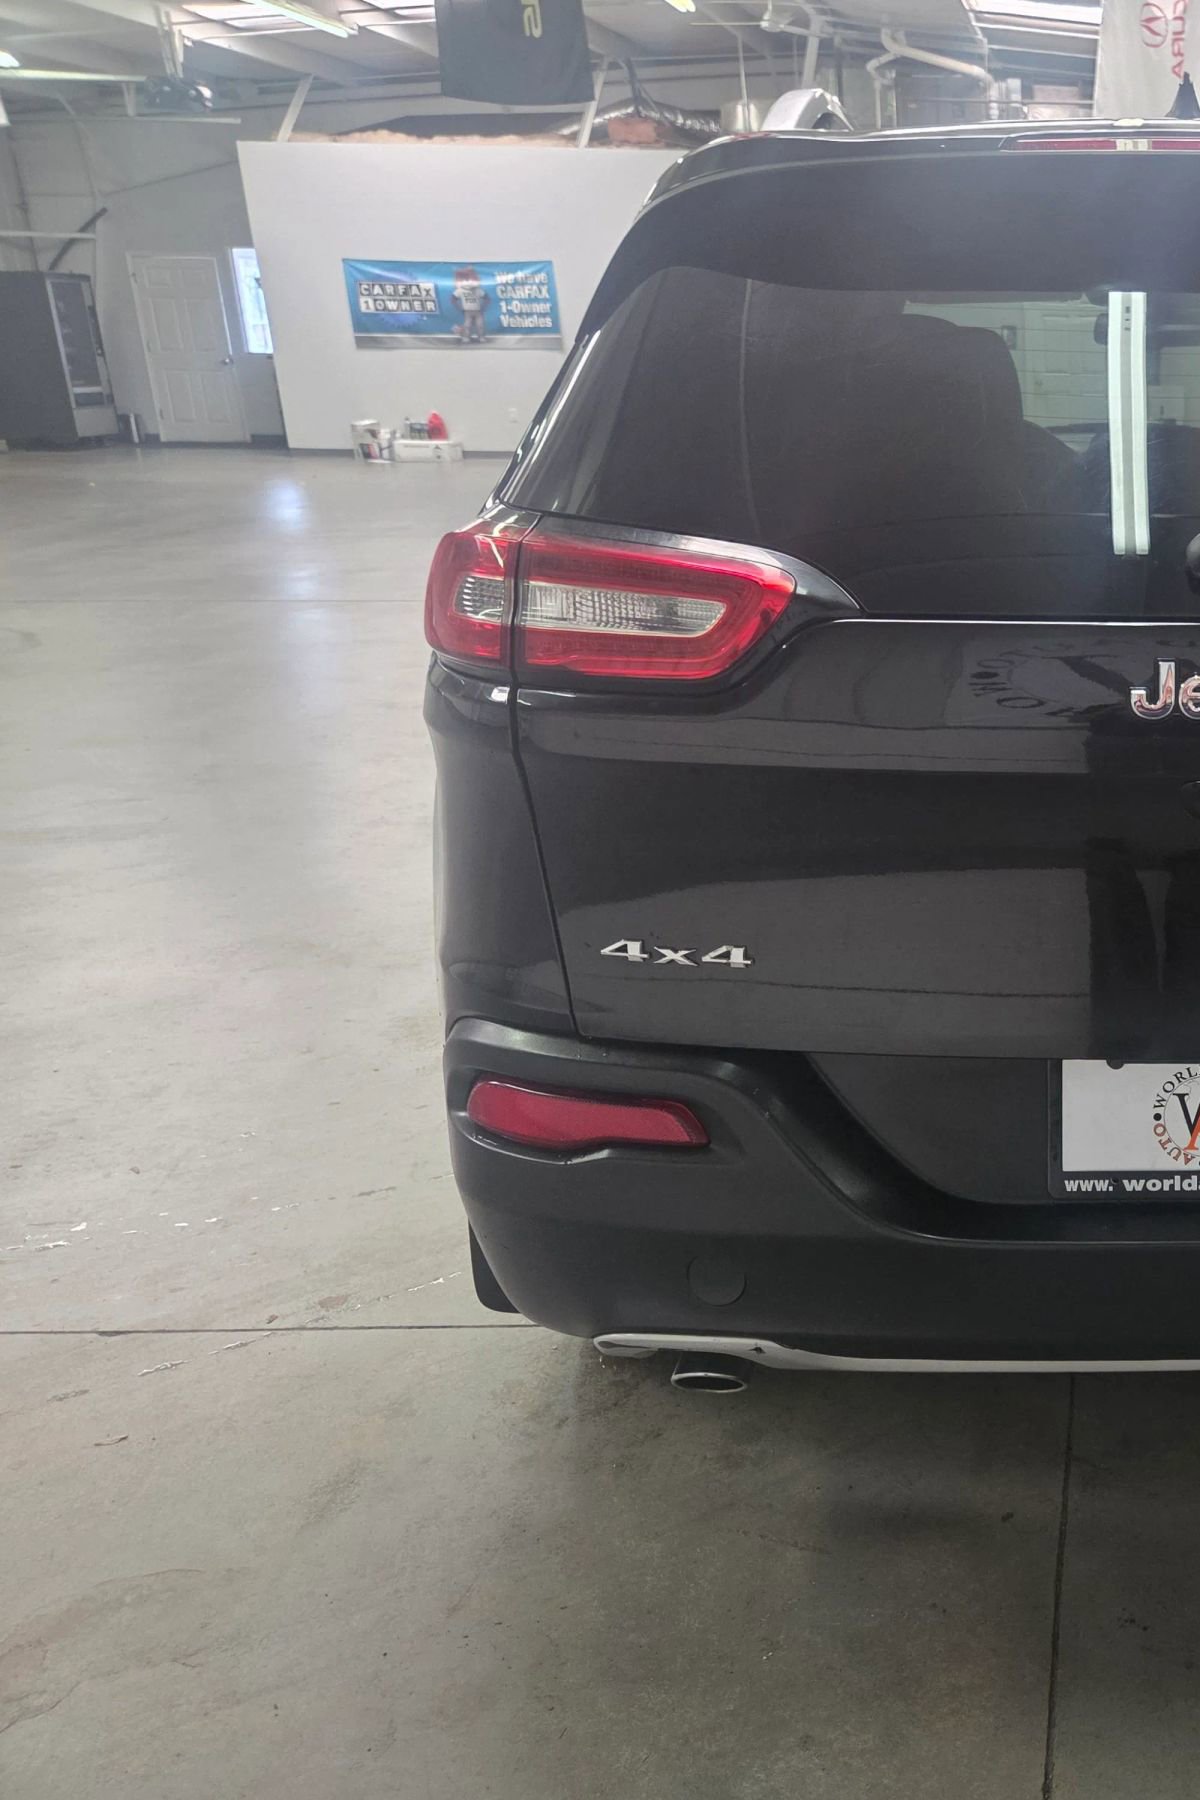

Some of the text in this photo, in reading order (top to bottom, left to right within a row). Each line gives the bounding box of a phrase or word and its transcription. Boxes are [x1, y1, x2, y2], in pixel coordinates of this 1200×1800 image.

[360, 284, 433, 298] CARFAX
[496, 285, 549, 299] CARFAX
[500, 300, 552, 313] 1-Owner
[500, 314, 552, 328] Vehicles
[1153, 1122, 1193, 1166] AUTO
